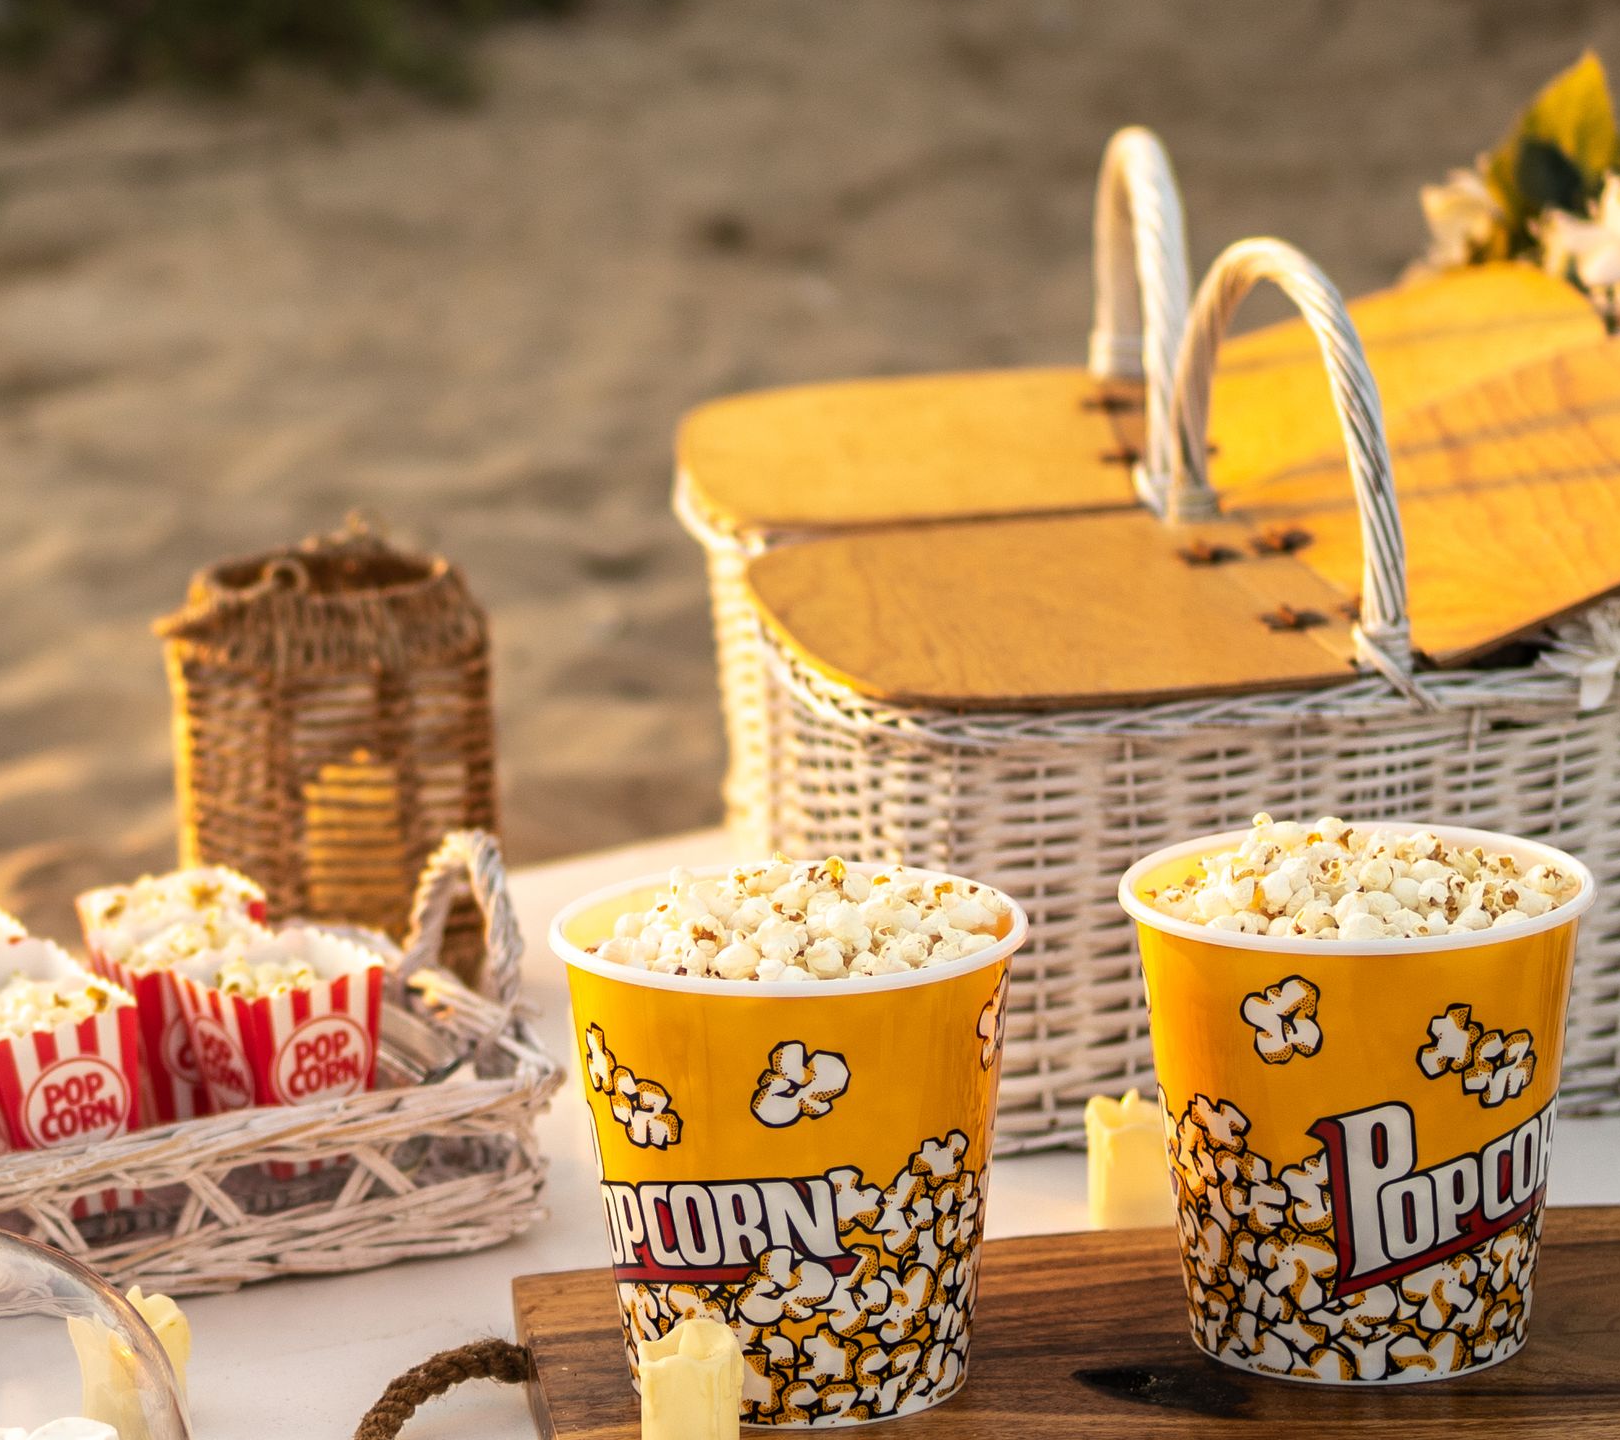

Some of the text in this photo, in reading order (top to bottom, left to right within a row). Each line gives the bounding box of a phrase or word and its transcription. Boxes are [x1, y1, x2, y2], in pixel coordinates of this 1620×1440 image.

[295, 1030, 349, 1072] POP
[42, 1071, 105, 1113] POP
[288, 1052, 361, 1098] CORN
[39, 1095, 121, 1143] CORN
[1335, 1090, 1559, 1279] POPCOR
